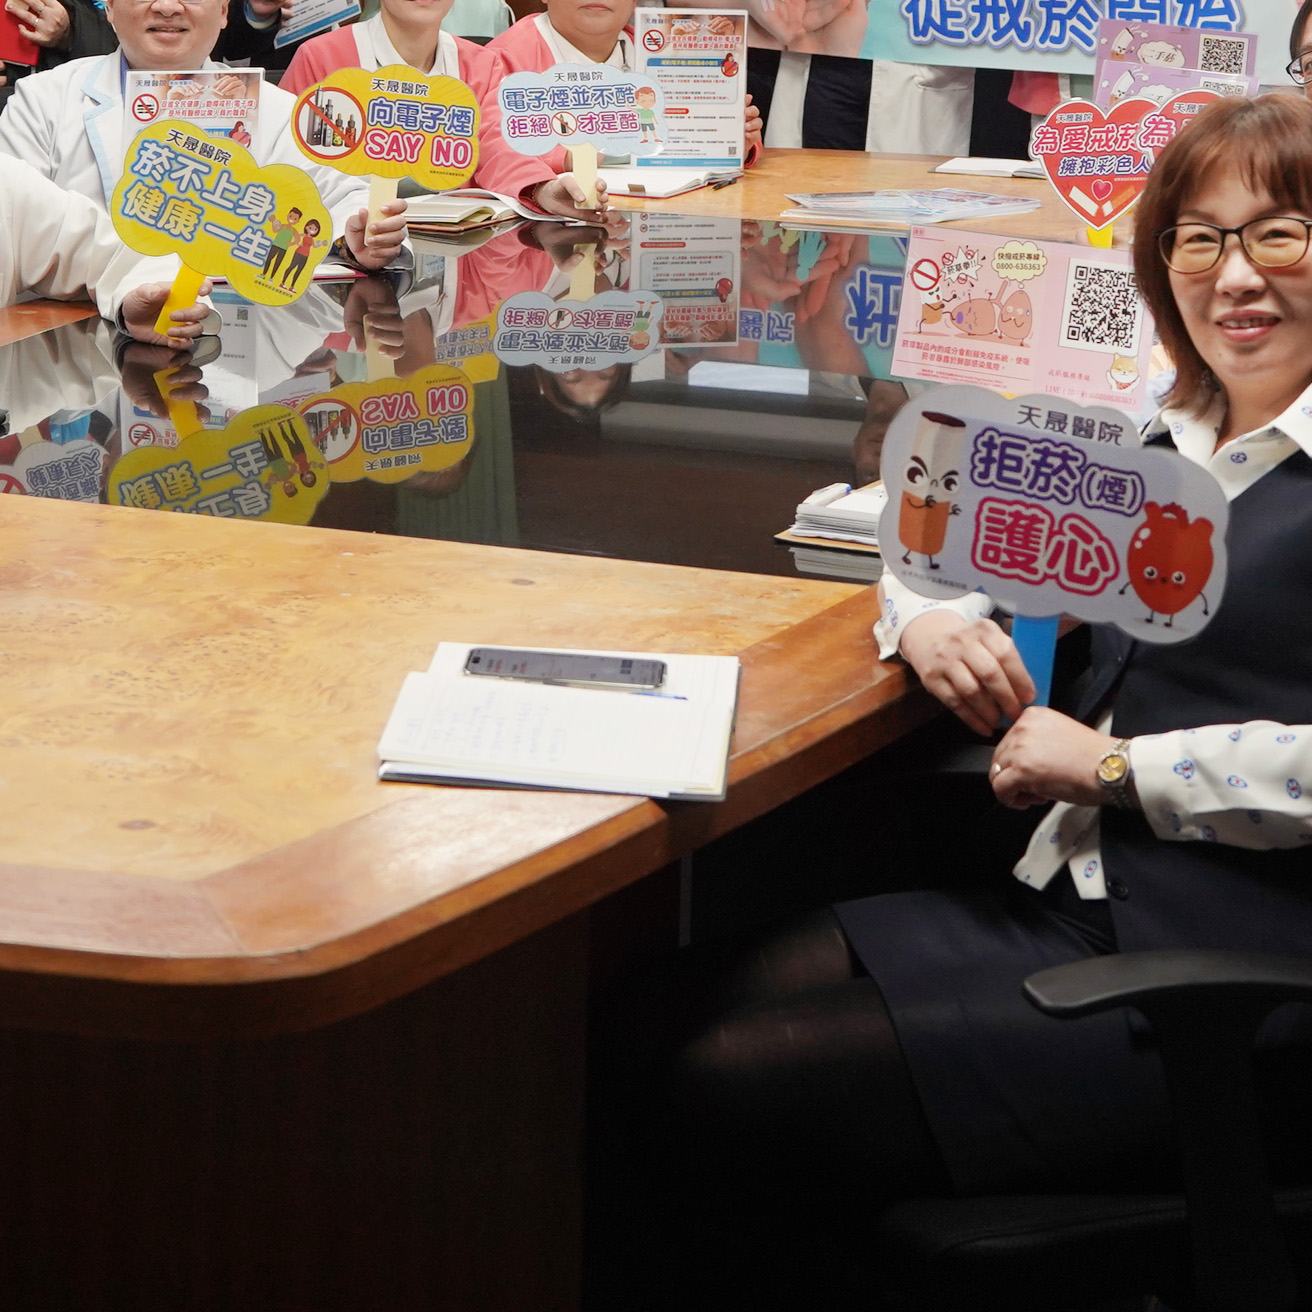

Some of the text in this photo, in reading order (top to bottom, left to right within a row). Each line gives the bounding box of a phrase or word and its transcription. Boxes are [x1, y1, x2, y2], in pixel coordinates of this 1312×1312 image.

[371, 77, 430, 97] 天晟醫院
[554, 71, 604, 83] 天晟醫院
[502, 83, 637, 112] 電子煙並不酷
[367, 98, 475, 138] 向電子煙
[507, 110, 641, 138] 拒絕 才是酷
[1056, 113, 1093, 123] 天晟醫院
[165, 128, 232, 166] 天晟醫院
[364, 128, 474, 168] SAY NO
[130, 139, 276, 225] 菸不上身
[123, 182, 272, 268] 健康一生
[996, 262, 1041, 271] 0800-636363
[997, 252, 1041, 262] 快撥戒菸專線
[1016, 404, 1124, 447] 天晟醫院
[970, 426, 1145, 518] 拒菸(煙)
[971, 496, 1120, 596] 護心
